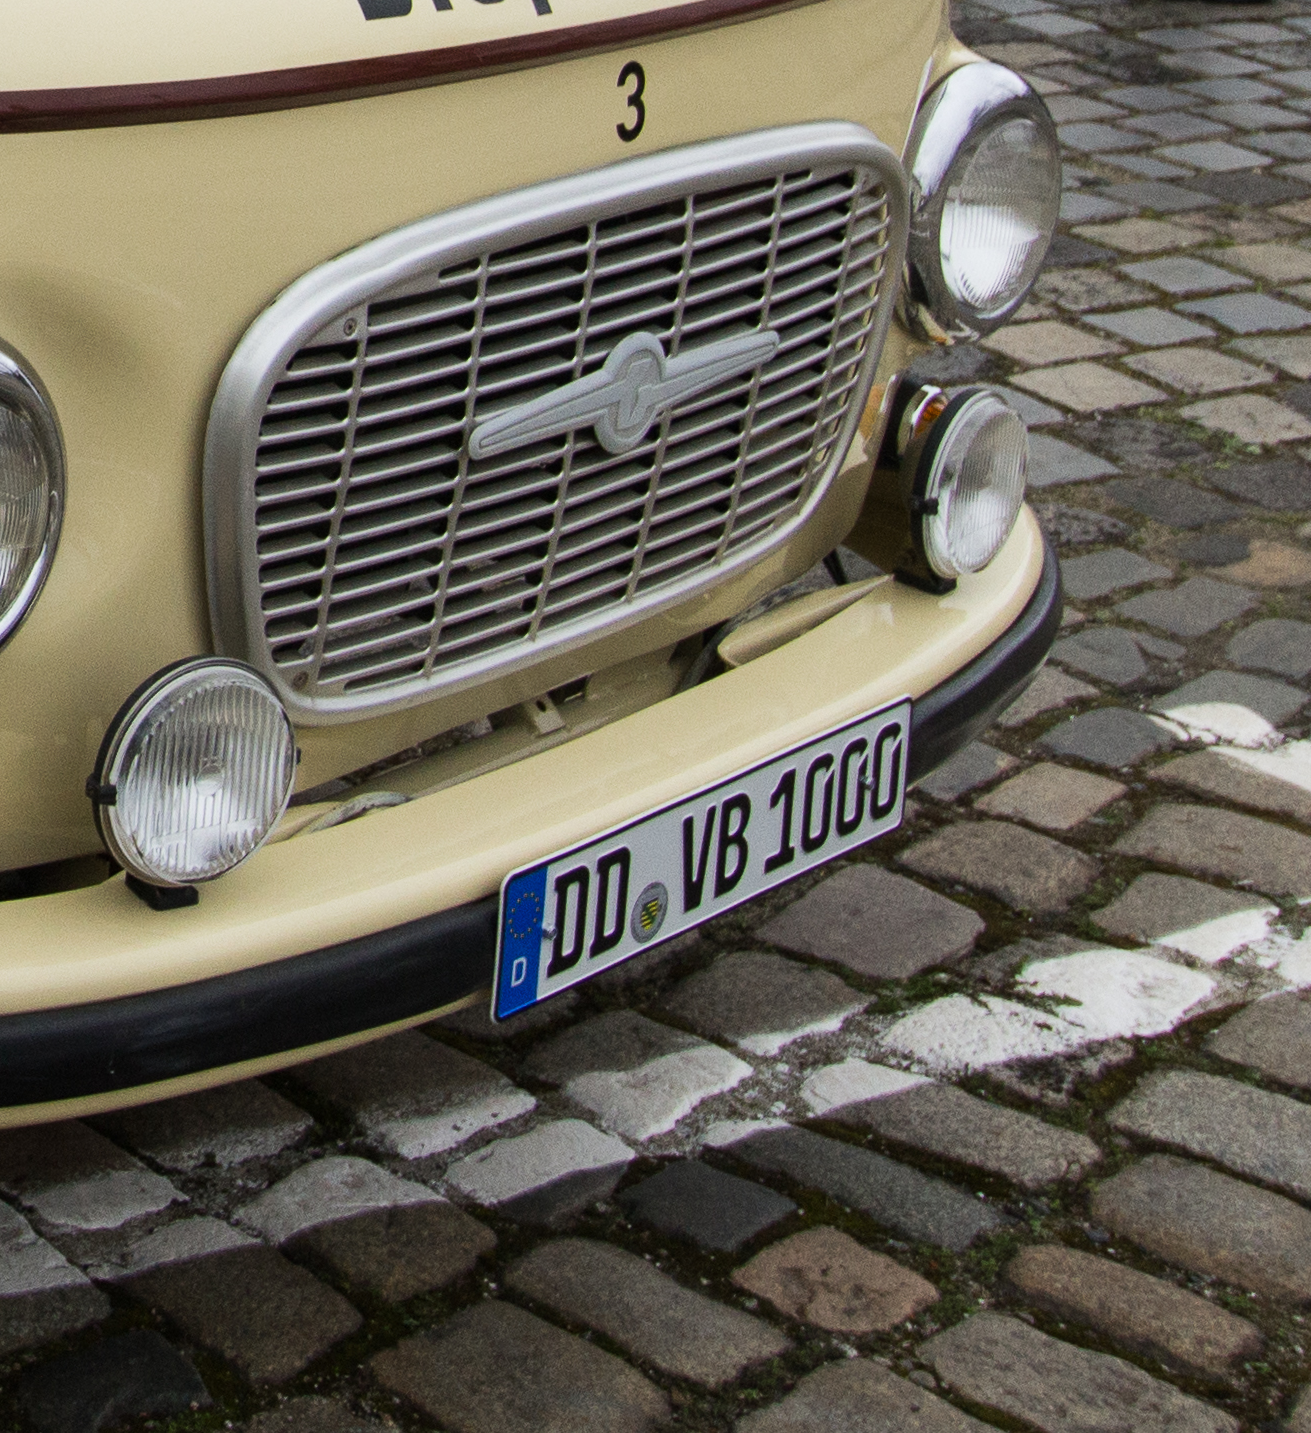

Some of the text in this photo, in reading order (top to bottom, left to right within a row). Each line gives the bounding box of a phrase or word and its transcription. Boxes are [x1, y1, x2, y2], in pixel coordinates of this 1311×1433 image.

[616, 60, 646, 142] 3
[510, 721, 903, 988] D DD VB 1000
